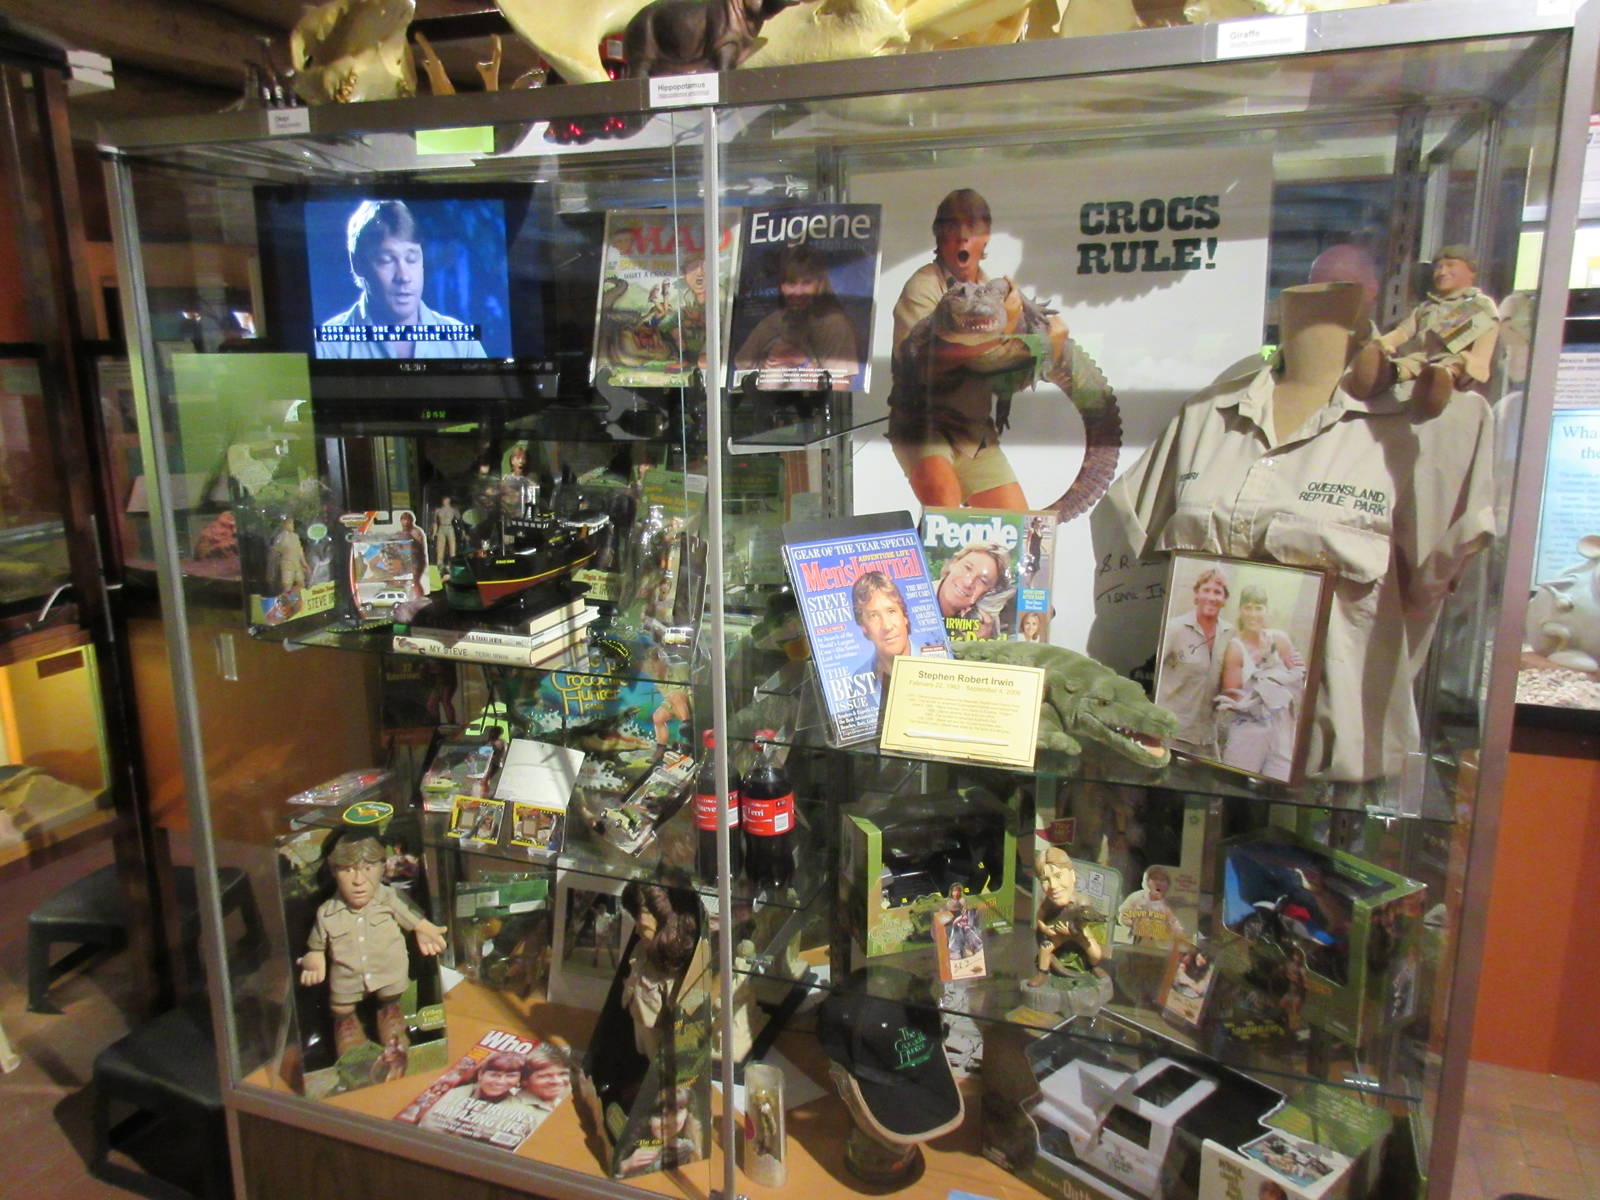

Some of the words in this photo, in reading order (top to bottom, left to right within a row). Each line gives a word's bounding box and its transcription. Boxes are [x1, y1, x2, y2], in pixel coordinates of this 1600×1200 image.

[1230, 29, 1260, 40] Giraffe
[657, 81, 706, 93] Hippopotamus
[1080, 195, 1220, 235] CROCS
[750, 212, 871, 248] Eugene
[1077, 237, 1218, 274] RULE!
[321, 325, 344, 333] AGRO
[350, 325, 367, 333] WAS
[372, 325, 389, 333] ONE
[395, 325, 405, 333] OF
[413, 325, 429, 333] THE
[435, 325, 475, 333] WILDEST
[322, 333, 367, 341] CAPTURES
[373, 333, 385, 341] IN
[390, 333, 400, 341] MY
[407, 333, 441, 341] ENTIRE
[447, 333, 475, 341] LIFE.
[1307, 481, 1386, 503] QUEENSLAND
[1298, 491, 1346, 507] REPTILE
[1353, 499, 1387, 517] PARK
[924, 514, 1018, 551] People
[794, 547, 821, 561] GEAR
[821, 546, 834, 557] OF
[834, 543, 855, 555] THE
[855, 540, 880, 554] YEAR
[880, 535, 917, 549] SPECIAL
[800, 557, 856, 592] Men's
[849, 549, 922, 581] Journal
[808, 591, 849, 613] STEVE
[810, 607, 852, 626] IRWIN
[945, 617, 980, 631] IRWIN'S
[429, 644, 441, 654] MY
[444, 646, 468, 657] STEVE
[826, 666, 850, 680] THE
[918, 670, 955, 682] Stephen
[957, 674, 988, 685] Robert
[991, 678, 1014, 687] Irwin
[829, 671, 877, 702] BEST
[833, 697, 869, 713] ISSUE
[480, 1030, 534, 1055] Who
